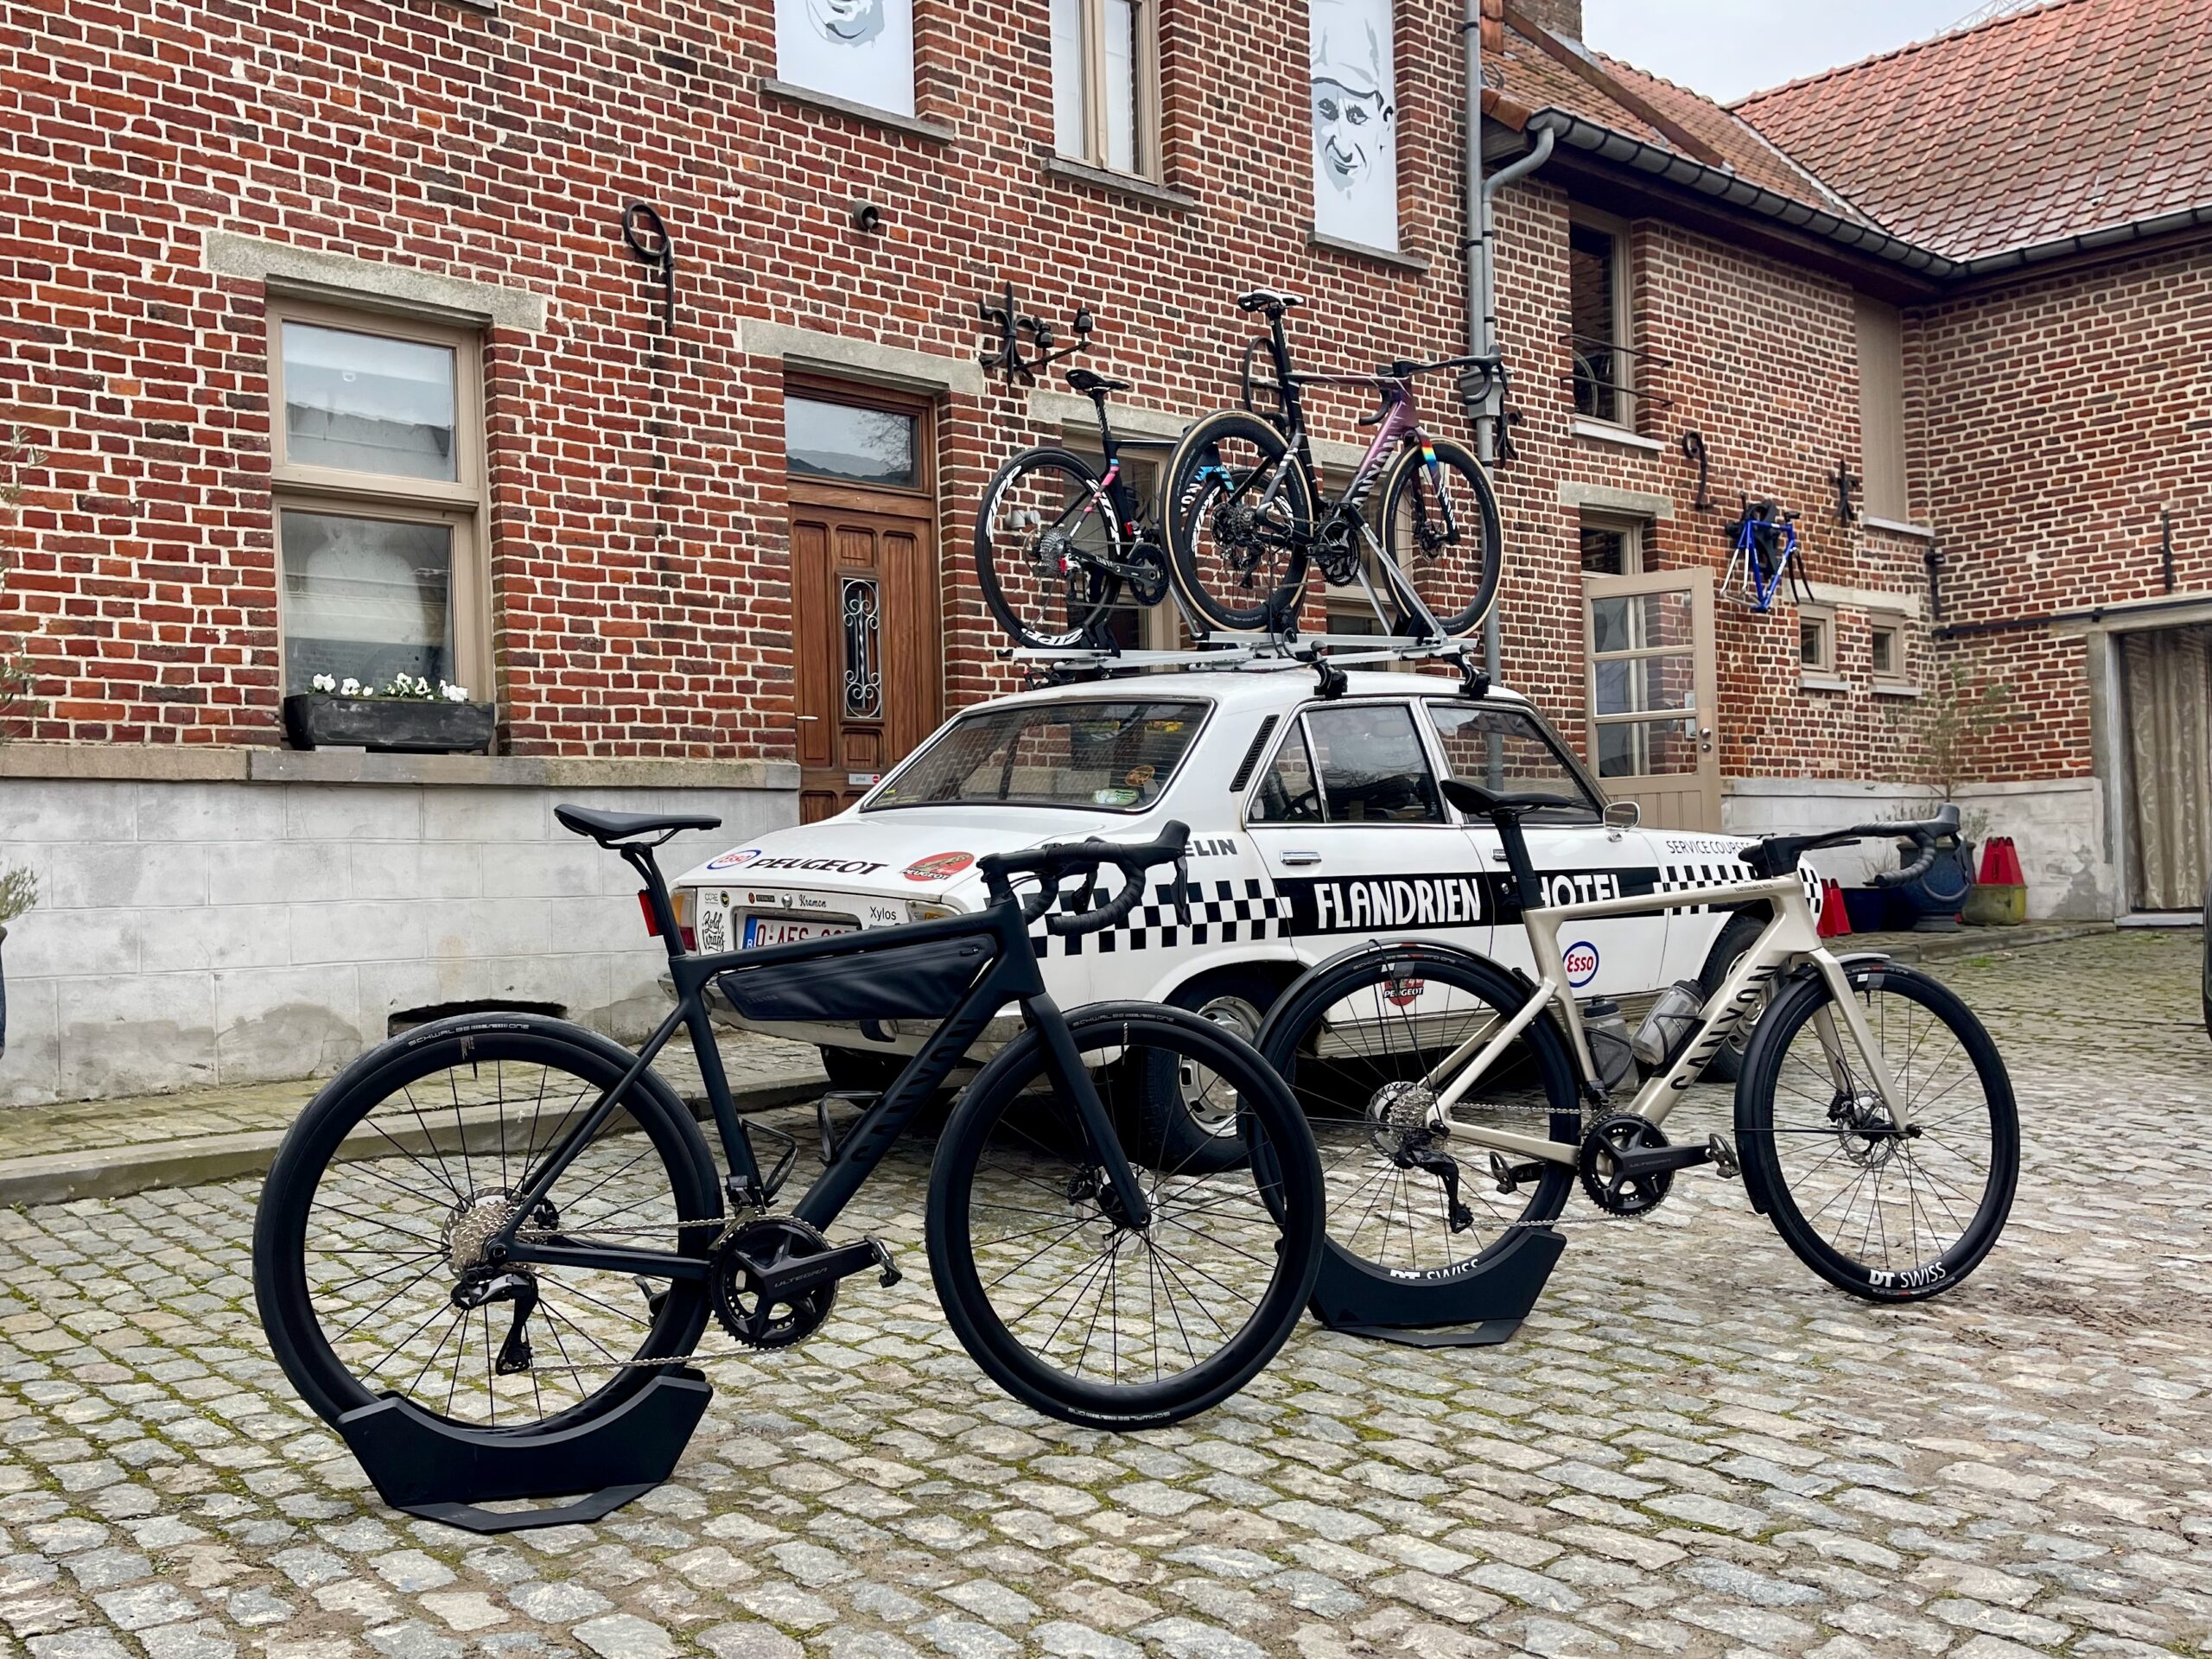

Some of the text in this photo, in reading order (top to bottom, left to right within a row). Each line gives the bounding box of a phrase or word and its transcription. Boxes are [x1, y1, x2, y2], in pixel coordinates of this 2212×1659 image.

[1351, 435, 1399, 508] ANYON
[1666, 840, 1711, 855] SERVICE
[746, 858, 890, 875] PEUGEOT
[869, 906, 897, 921] Xylos
[1313, 878, 1481, 929] FLANDRIEN
[1670, 965, 1782, 1090] CANYON
[1868, 1261, 1947, 1288] DT SWISS
